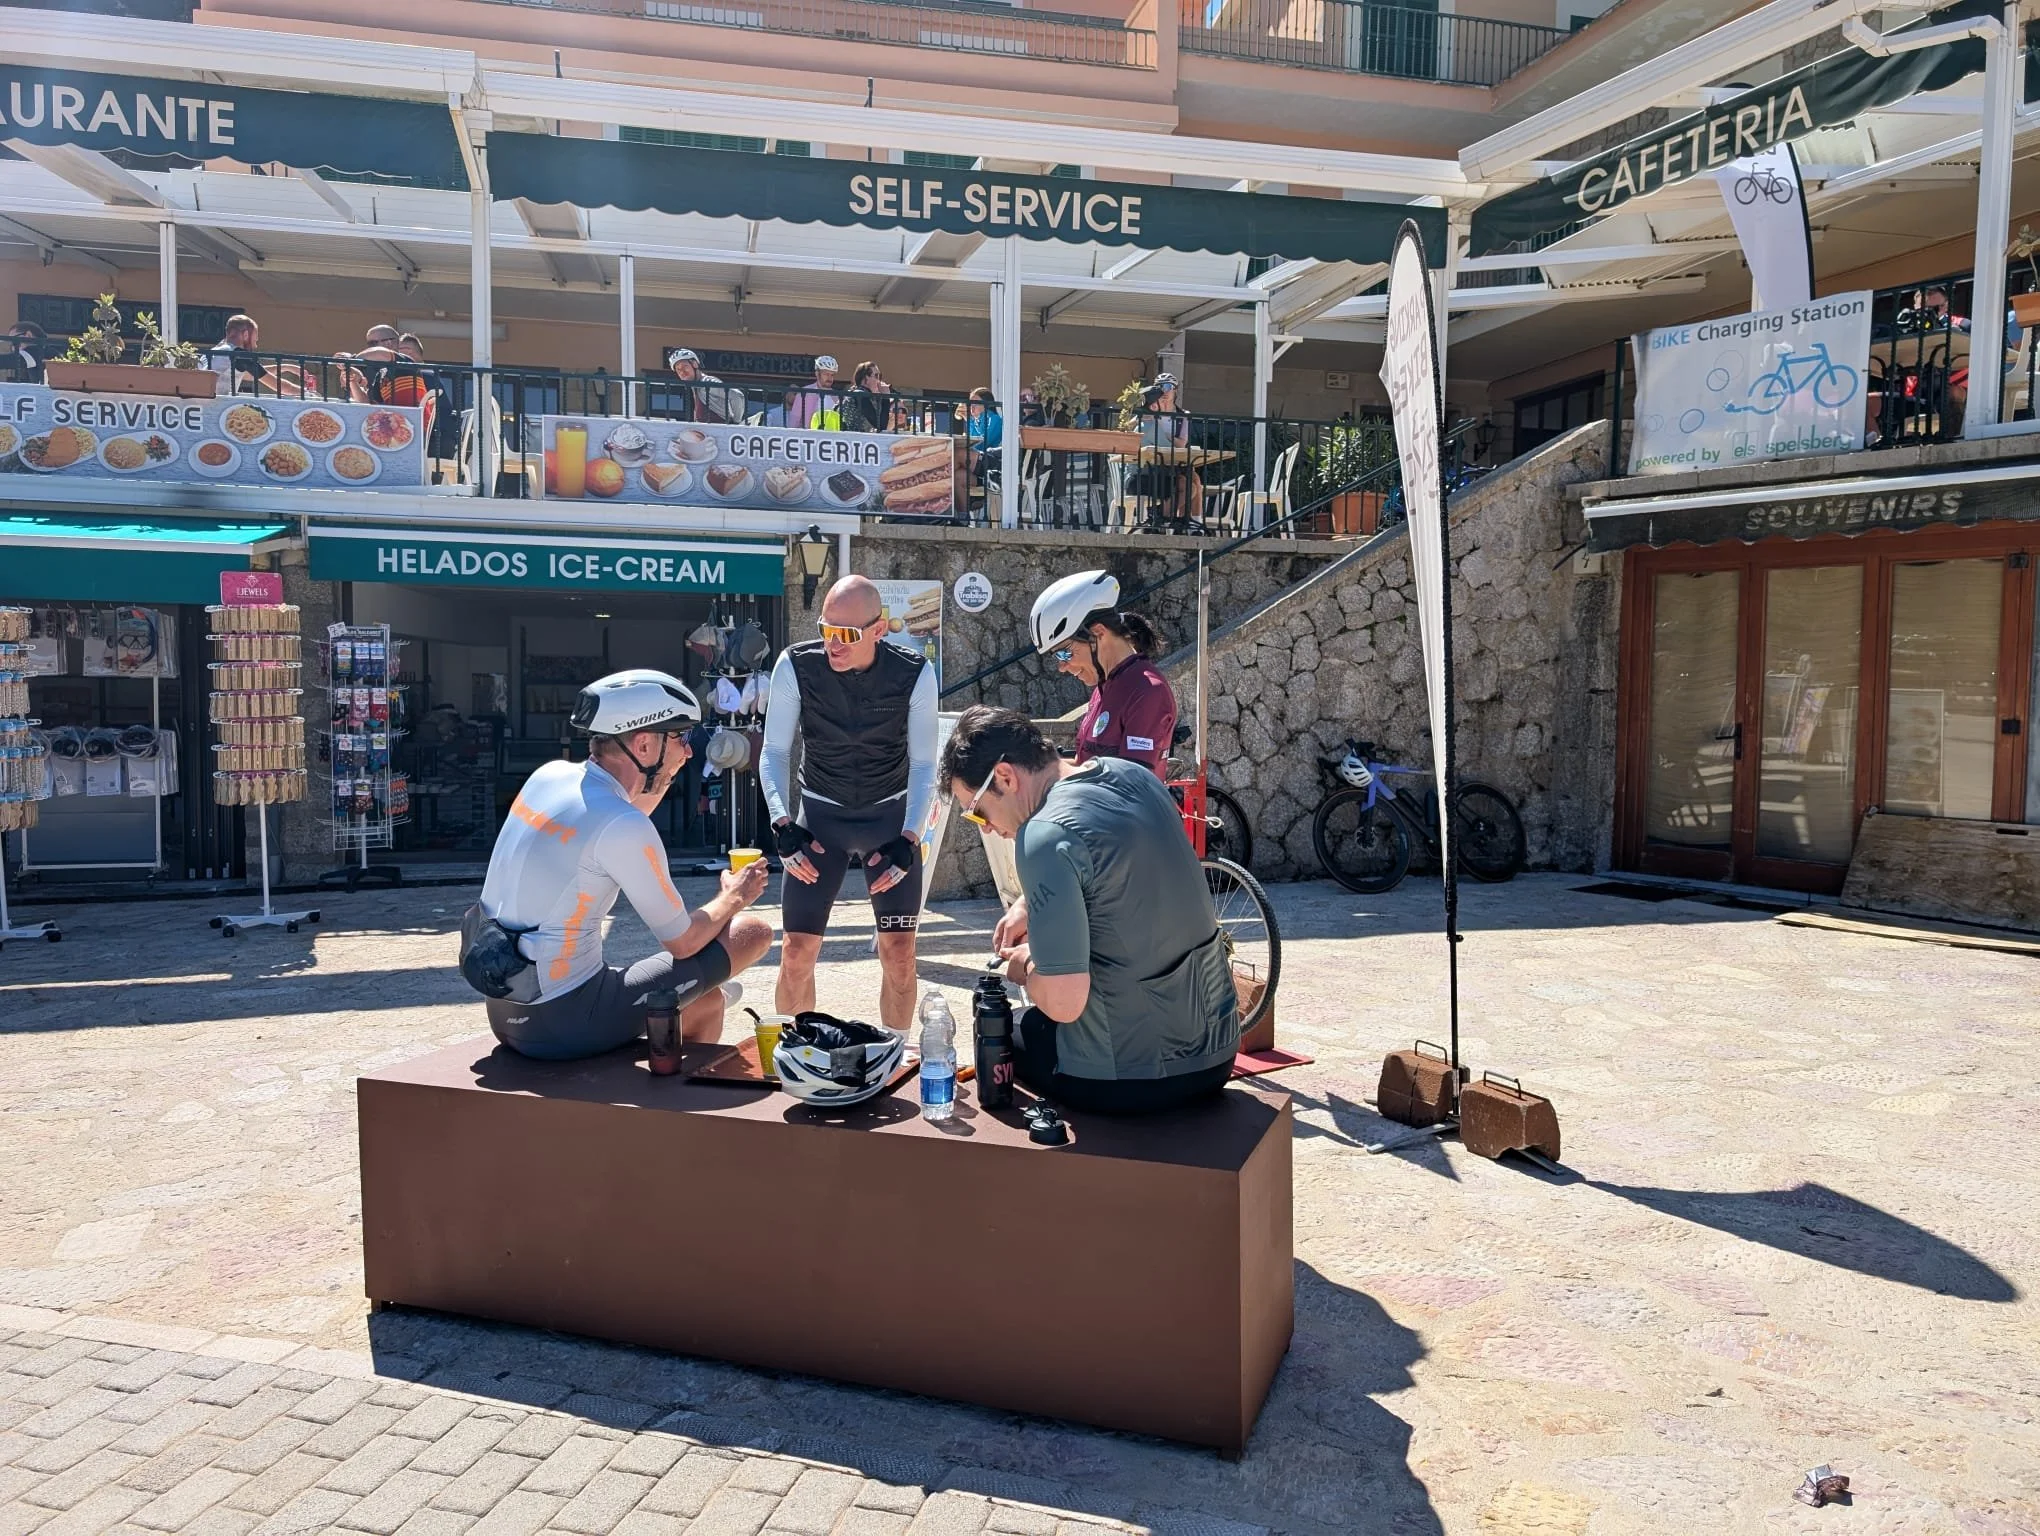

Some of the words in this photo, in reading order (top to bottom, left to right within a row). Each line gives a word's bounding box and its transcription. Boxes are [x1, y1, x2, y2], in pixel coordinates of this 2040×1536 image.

[0, 82, 235, 145] URANTE
[1577, 85, 1813, 212] CAFETERIA
[849, 175, 1143, 235] SELF-SERVICE
[1697, 313, 1784, 341] Charging
[1791, 300, 1865, 325] Station
[54, 398, 202, 431] SERVICE
[730, 435, 879, 465] CAFETERIA
[1635, 449, 1696, 472] powered
[1702, 447, 1720, 464] by
[1745, 490, 1963, 530] SOUVENIRS
[378, 547, 528, 578] HELADOS
[549, 553, 725, 584] ICE-CREAM
[614, 707, 674, 732] S-WORKS
